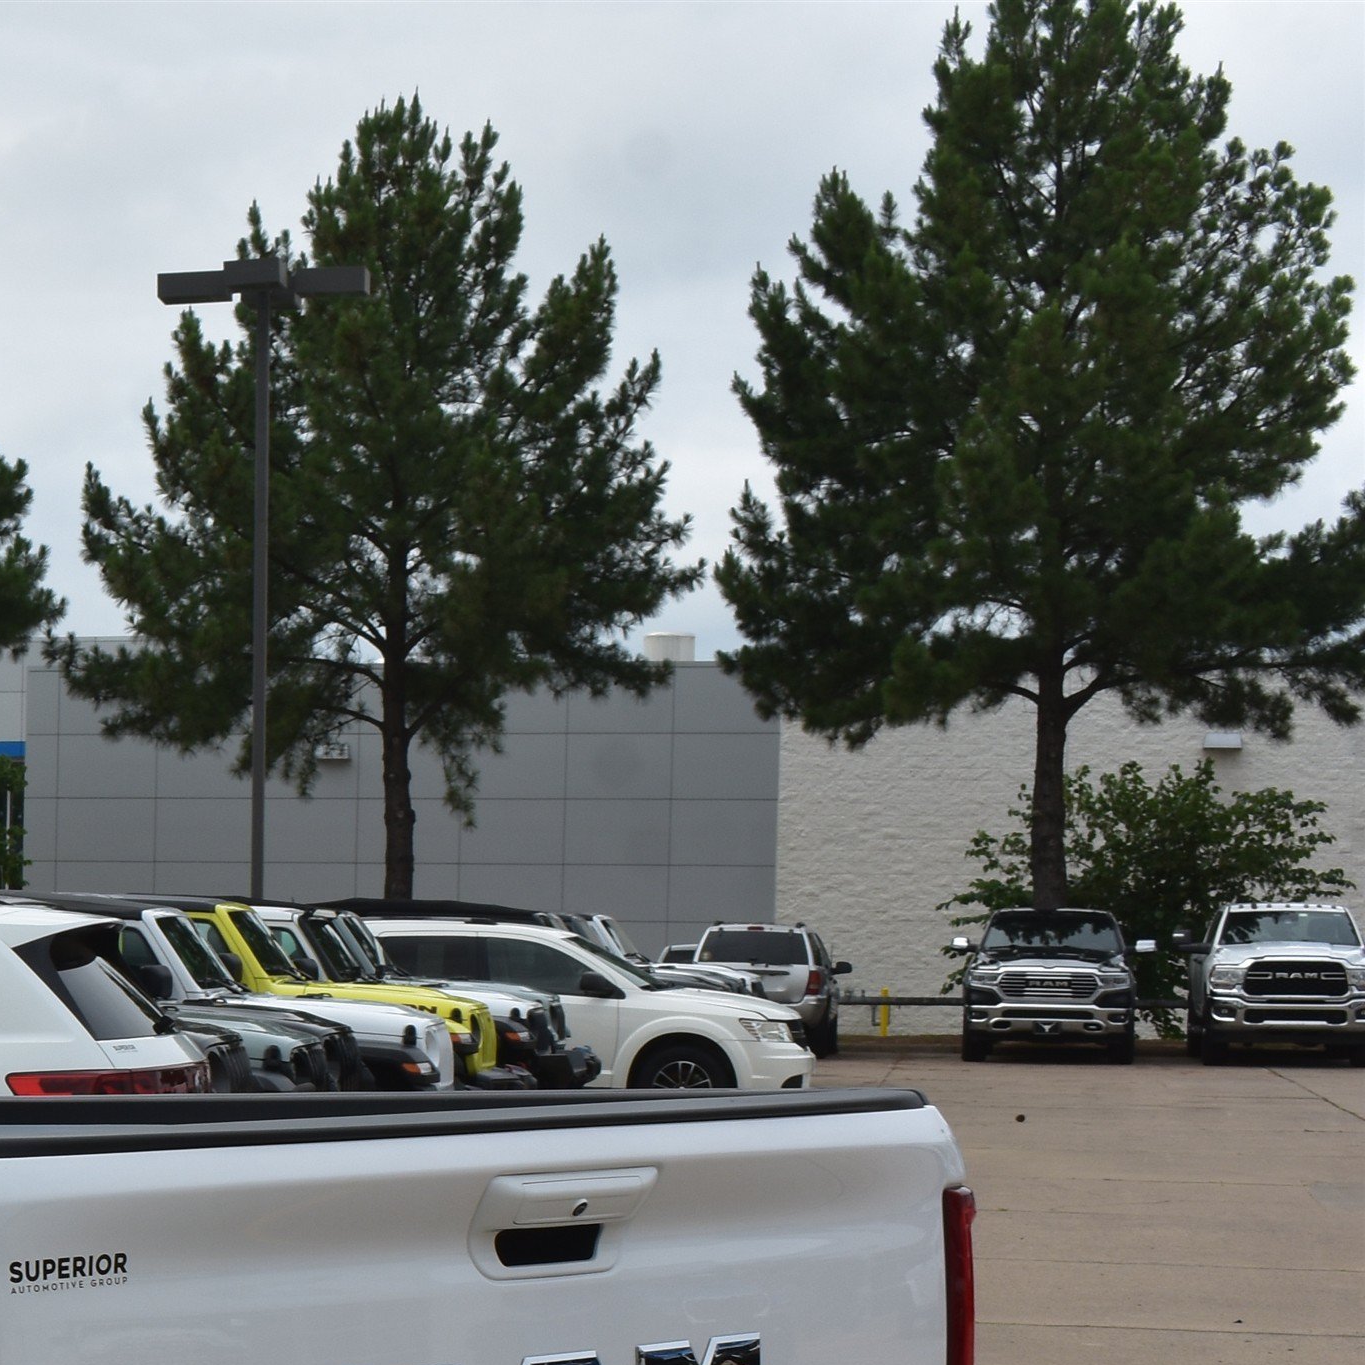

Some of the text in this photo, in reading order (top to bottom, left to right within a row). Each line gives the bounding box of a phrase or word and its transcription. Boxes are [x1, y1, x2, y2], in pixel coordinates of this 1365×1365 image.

[9, 1253, 127, 1283] SUPERIOR
[11, 1276, 128, 1294] AUTOMOTIVE GROUP
